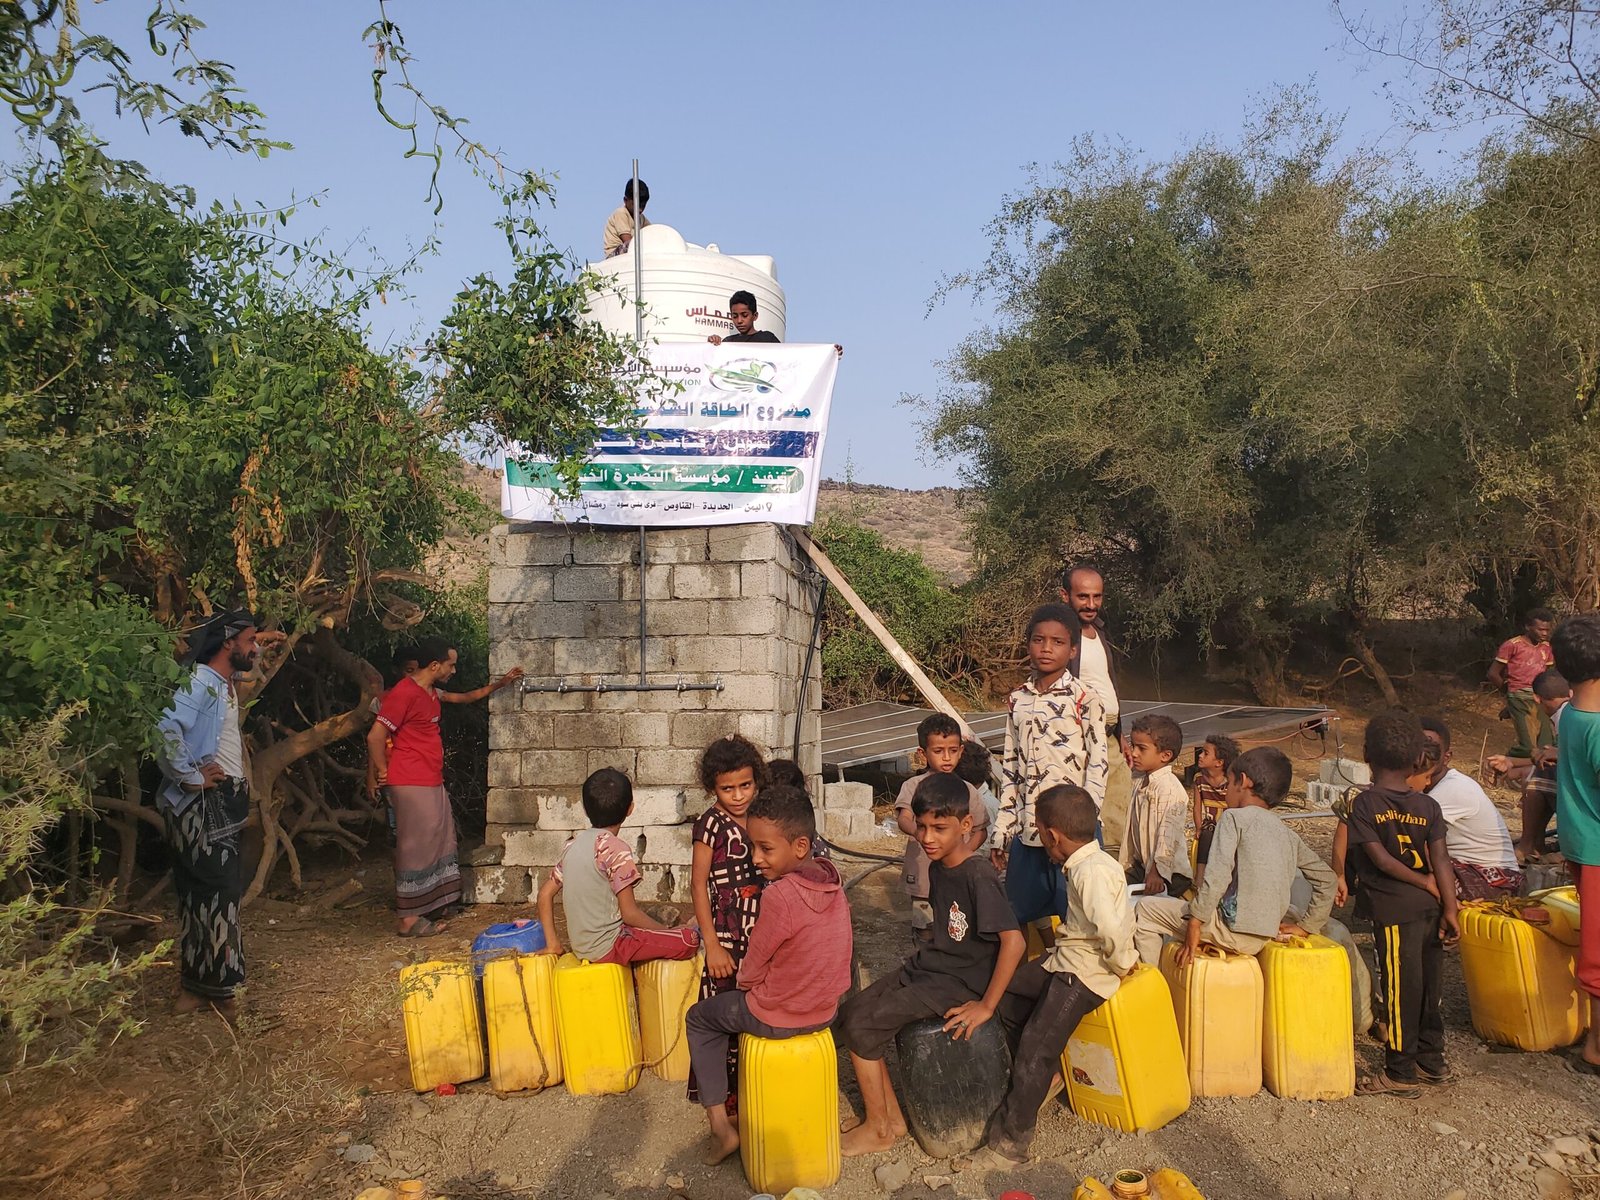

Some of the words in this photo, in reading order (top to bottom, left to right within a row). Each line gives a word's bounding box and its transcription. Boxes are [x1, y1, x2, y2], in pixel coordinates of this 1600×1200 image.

[695, 317, 734, 330] HAMMAS
[700, 401, 750, 418] الطاقة
[756, 402, 811, 422] مشروع
[613, 467, 669, 486] البصيرة
[674, 469, 731, 487] مؤسسة
[751, 470, 787, 488] تنفيذ
[663, 502, 695, 511] القناوص
[702, 502, 734, 513] الحديدة
[1397, 834, 1424, 869] 5
